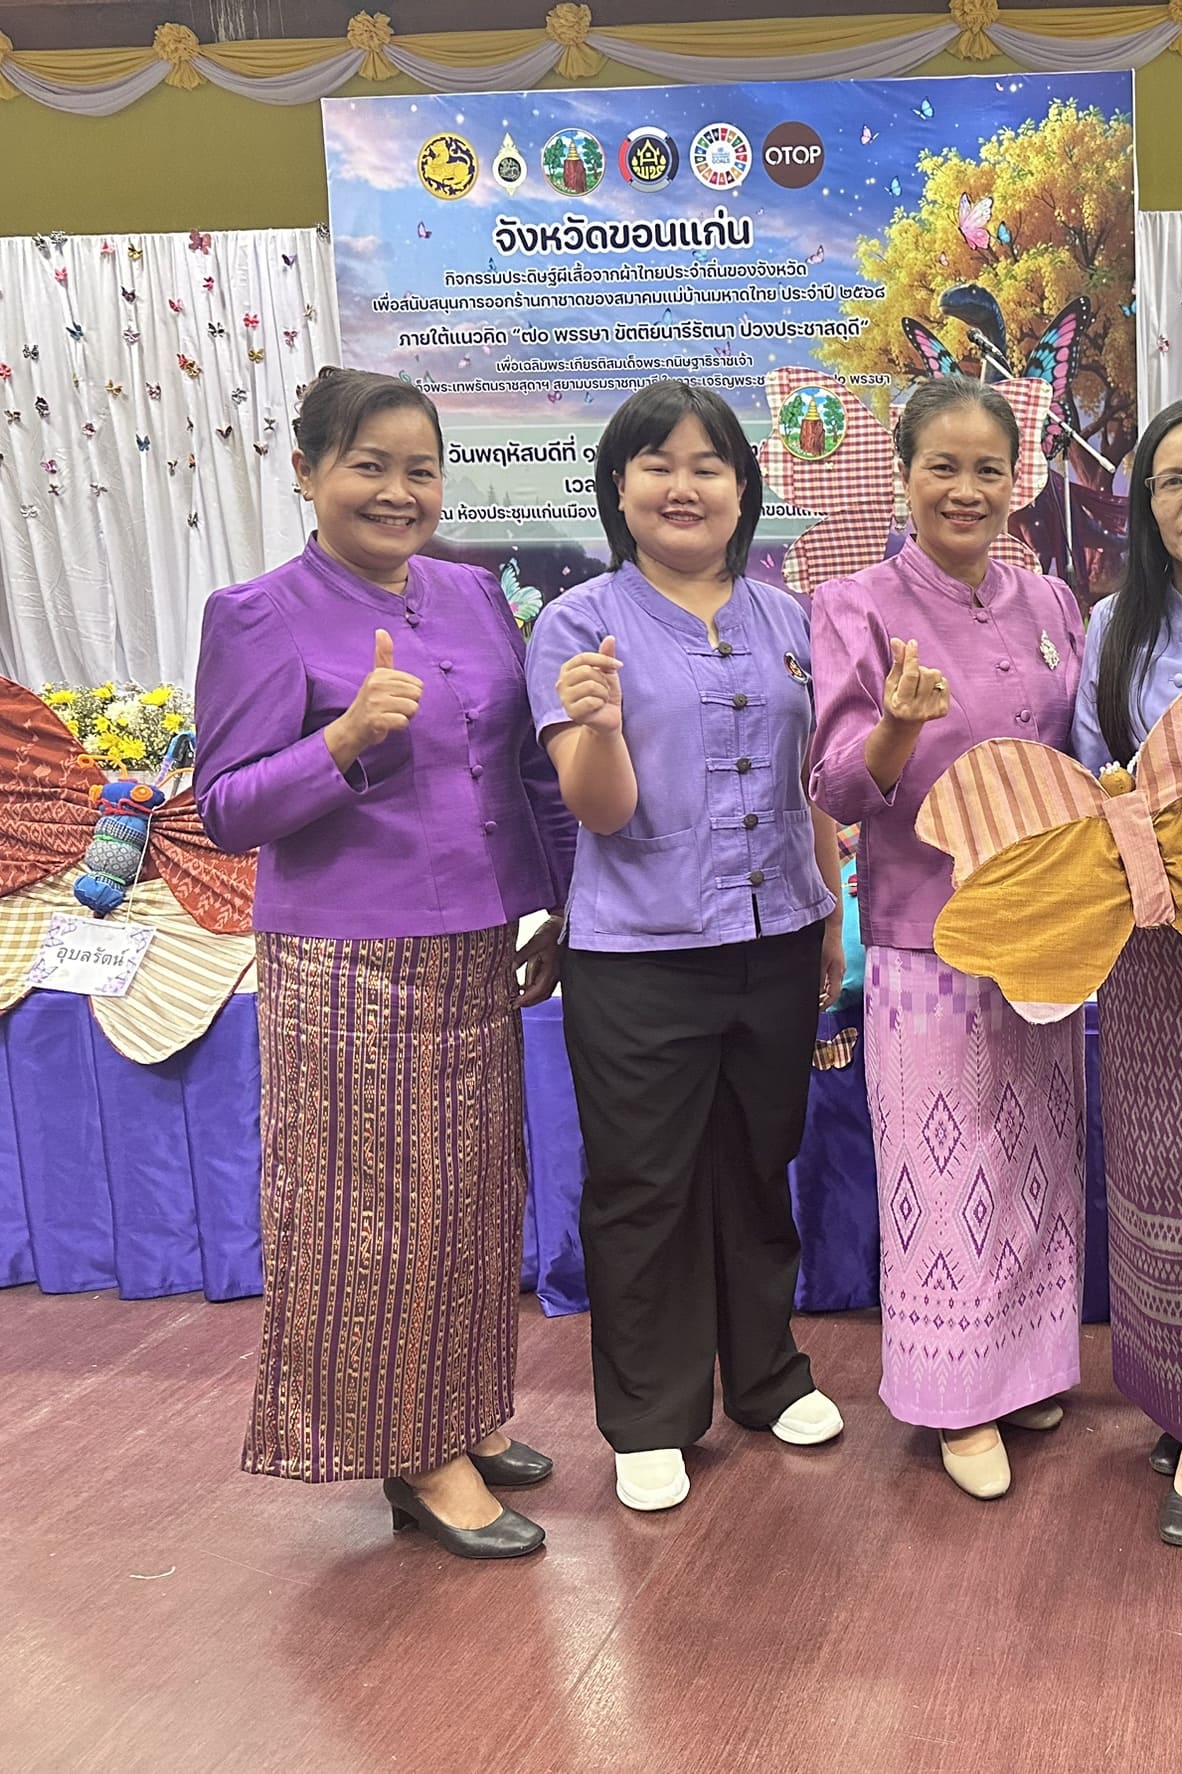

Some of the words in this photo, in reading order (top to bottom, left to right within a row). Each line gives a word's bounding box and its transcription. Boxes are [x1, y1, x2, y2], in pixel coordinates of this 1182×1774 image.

[765, 145, 821, 165] OTOP
[497, 208, 751, 252] จังหวัดขอนแก่น
[445, 263, 807, 287] กิจกรรมประดิษฐ์ผีเสื้อจากผ้าไทยประจำถิ่นของจังหวัด
[373, 285, 776, 312] เพื่อสนับสนุนการออกร้านกาชาดของสมาคมแม่บ้านมหาดไทย
[782, 286, 833, 300] ประจำปี
[840, 285, 885, 299] ๒๕๖๘
[400, 328, 506, 346] ภายใต้แนวคิด
[555, 329, 609, 342] พรรษา
[615, 322, 734, 341] ขัตติยนารีรัตนา
[497, 354, 753, 372] เพื่อเฉลิมพระเกียรติสมเด็จพระกนิษฐาธิราชเจ้า
[850, 375, 890, 385] พรรษา
[449, 435, 576, 466] วันพฤหัสบดีที่
[583, 445, 598, 463] ๑
[565, 479, 596, 493] เวล
[458, 503, 597, 523] ห้องประชุมแก่นเมือง
[57, 946, 130, 967] อุบลรัตน์
